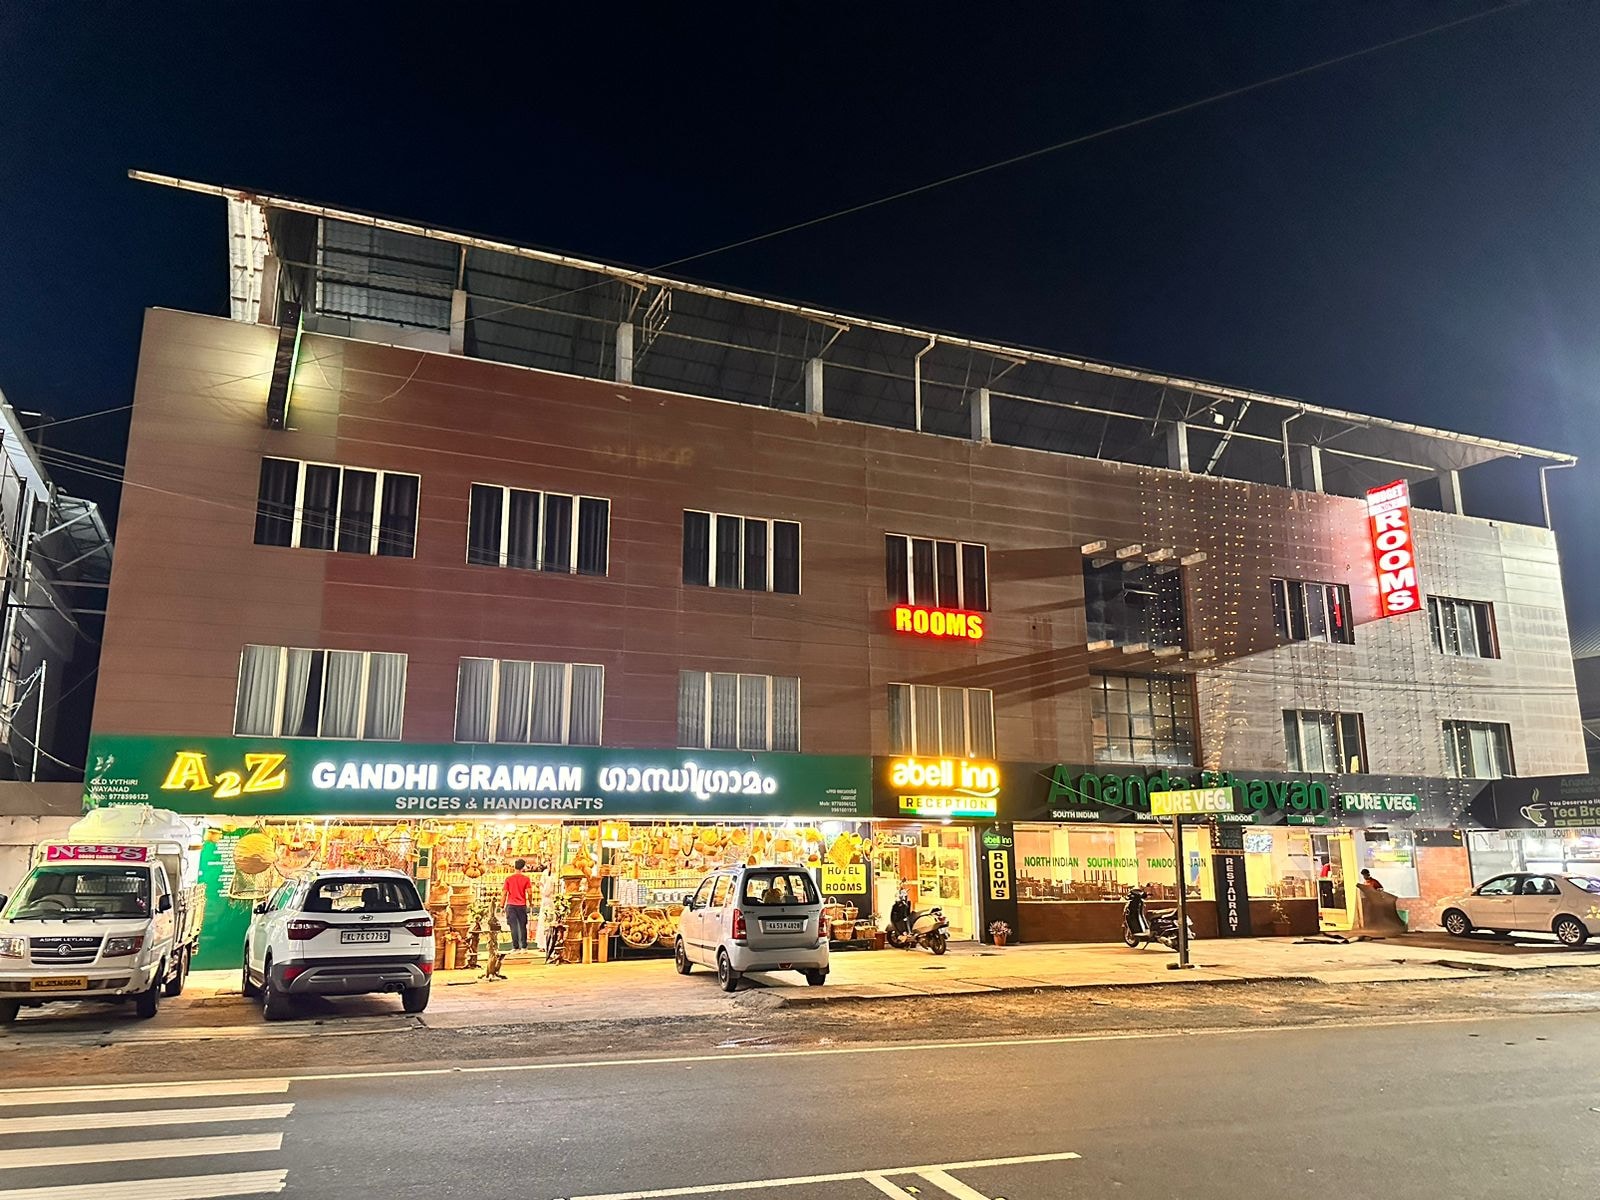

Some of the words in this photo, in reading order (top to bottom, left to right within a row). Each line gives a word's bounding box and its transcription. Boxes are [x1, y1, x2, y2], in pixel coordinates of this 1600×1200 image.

[1375, 508, 1416, 611] ROOMS
[895, 607, 983, 639] ROOMS
[160, 751, 287, 798] A2Z
[311, 761, 438, 790] GANDHI
[447, 763, 582, 791] GRAMAM
[892, 758, 953, 787] abell
[960, 761, 1000, 788] inn
[395, 796, 461, 810] SPICES
[464, 796, 479, 810] &
[483, 797, 604, 810] HANDICRAFTS
[906, 797, 989, 809] RECEPTION
[1153, 791, 1192, 813] PURE
[1192, 788, 1232, 811] VEG.
[1345, 794, 1382, 810] PURE
[1382, 795, 1417, 811] VEG.
[1052, 810, 1075, 818] SOUTH
[1076, 811, 1099, 819] INDIAN
[1223, 814, 1253, 822] TANDOOR
[1550, 806, 1577, 818] Tea
[1024, 856, 1051, 867] NORTH
[1052, 857, 1079, 867] INDIAN
[1087, 857, 1113, 868] SOUTH
[1113, 857, 1139, 868] INDIAN
[1146, 857, 1177, 868] TANDOO
[1190, 857, 1207, 868] JAIN
[993, 852, 1006, 898] ROOMS
[825, 883, 863, 891] ROOMS
[1224, 857, 1239, 932] RESTAURANT
